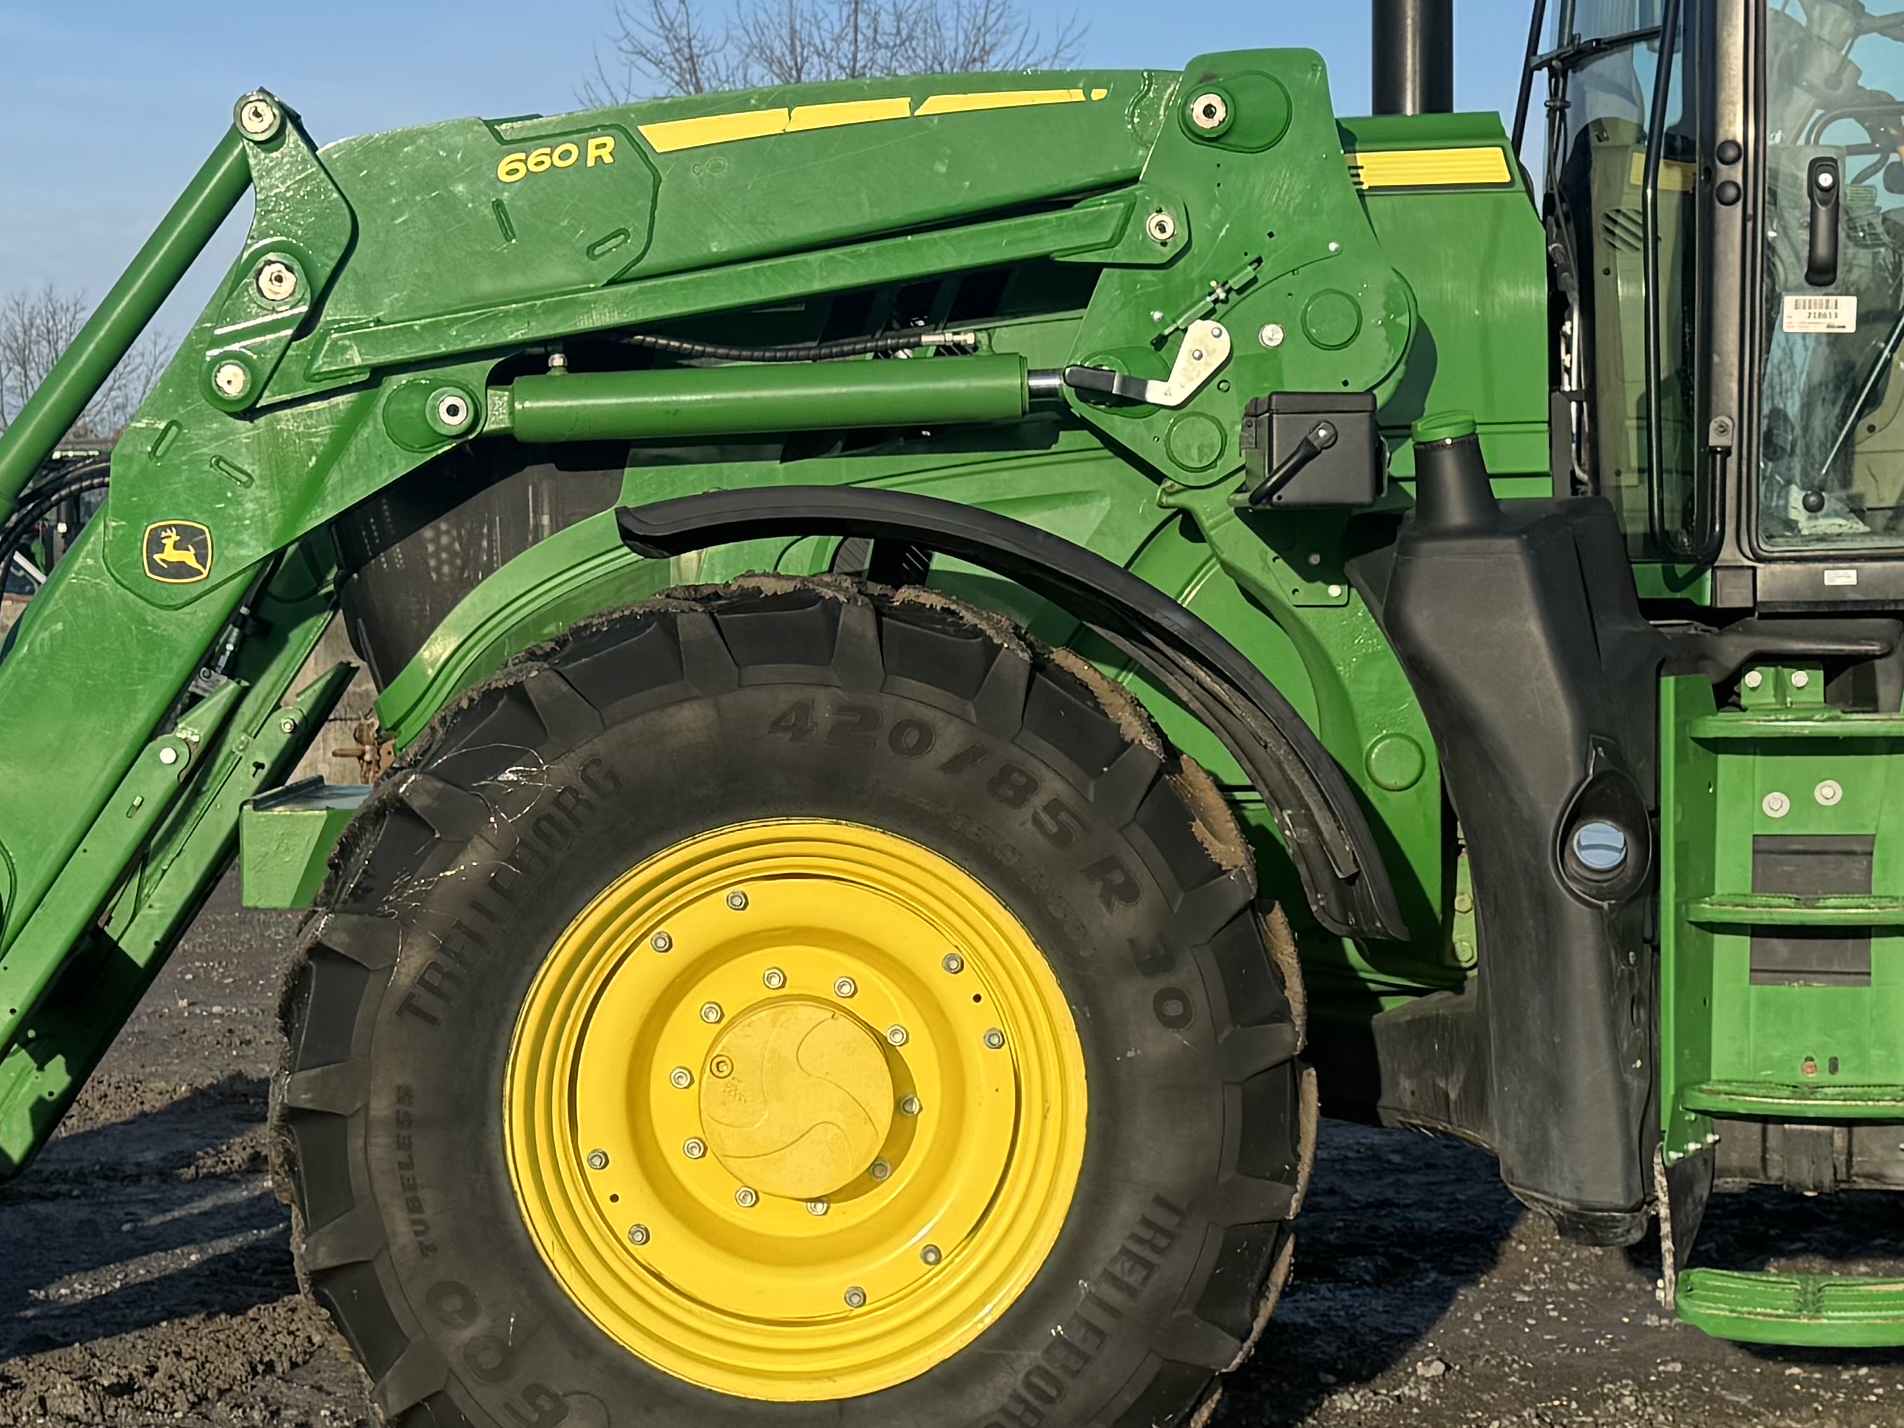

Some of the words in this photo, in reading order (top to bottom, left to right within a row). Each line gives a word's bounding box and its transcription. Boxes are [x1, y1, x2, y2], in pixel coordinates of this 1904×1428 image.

[496, 143, 580, 183] 660
[586, 136, 615, 168] R
[397, 754, 624, 1028] TRELLEBORG
[769, 697, 1086, 851] 420/85
[1077, 846, 1145, 919] R
[1124, 923, 1196, 1035] 30
[393, 1084, 440, 1259] TUBELESS
